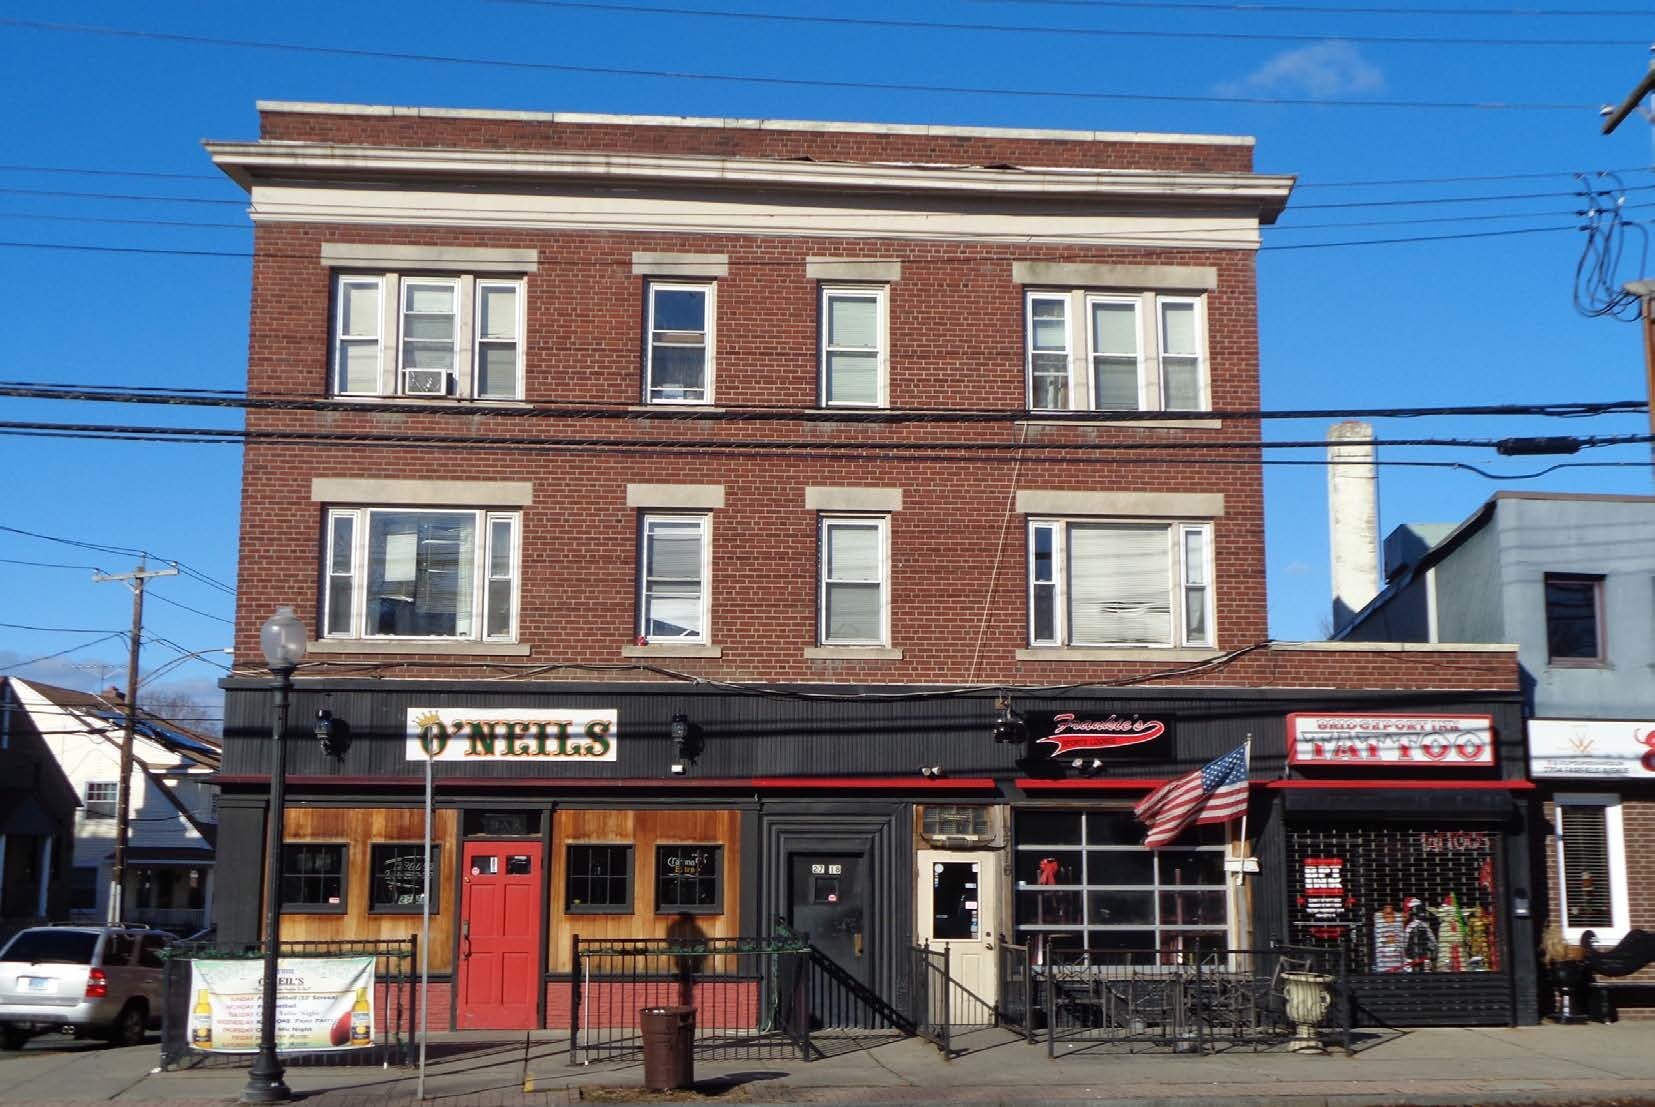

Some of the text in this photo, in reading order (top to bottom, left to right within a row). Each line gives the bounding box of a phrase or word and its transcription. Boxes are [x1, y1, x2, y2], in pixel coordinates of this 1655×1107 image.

[418, 719, 612, 758] O'NEILS
[1053, 713, 1145, 734] Frankie's
[1299, 731, 1486, 761] TATTOO
